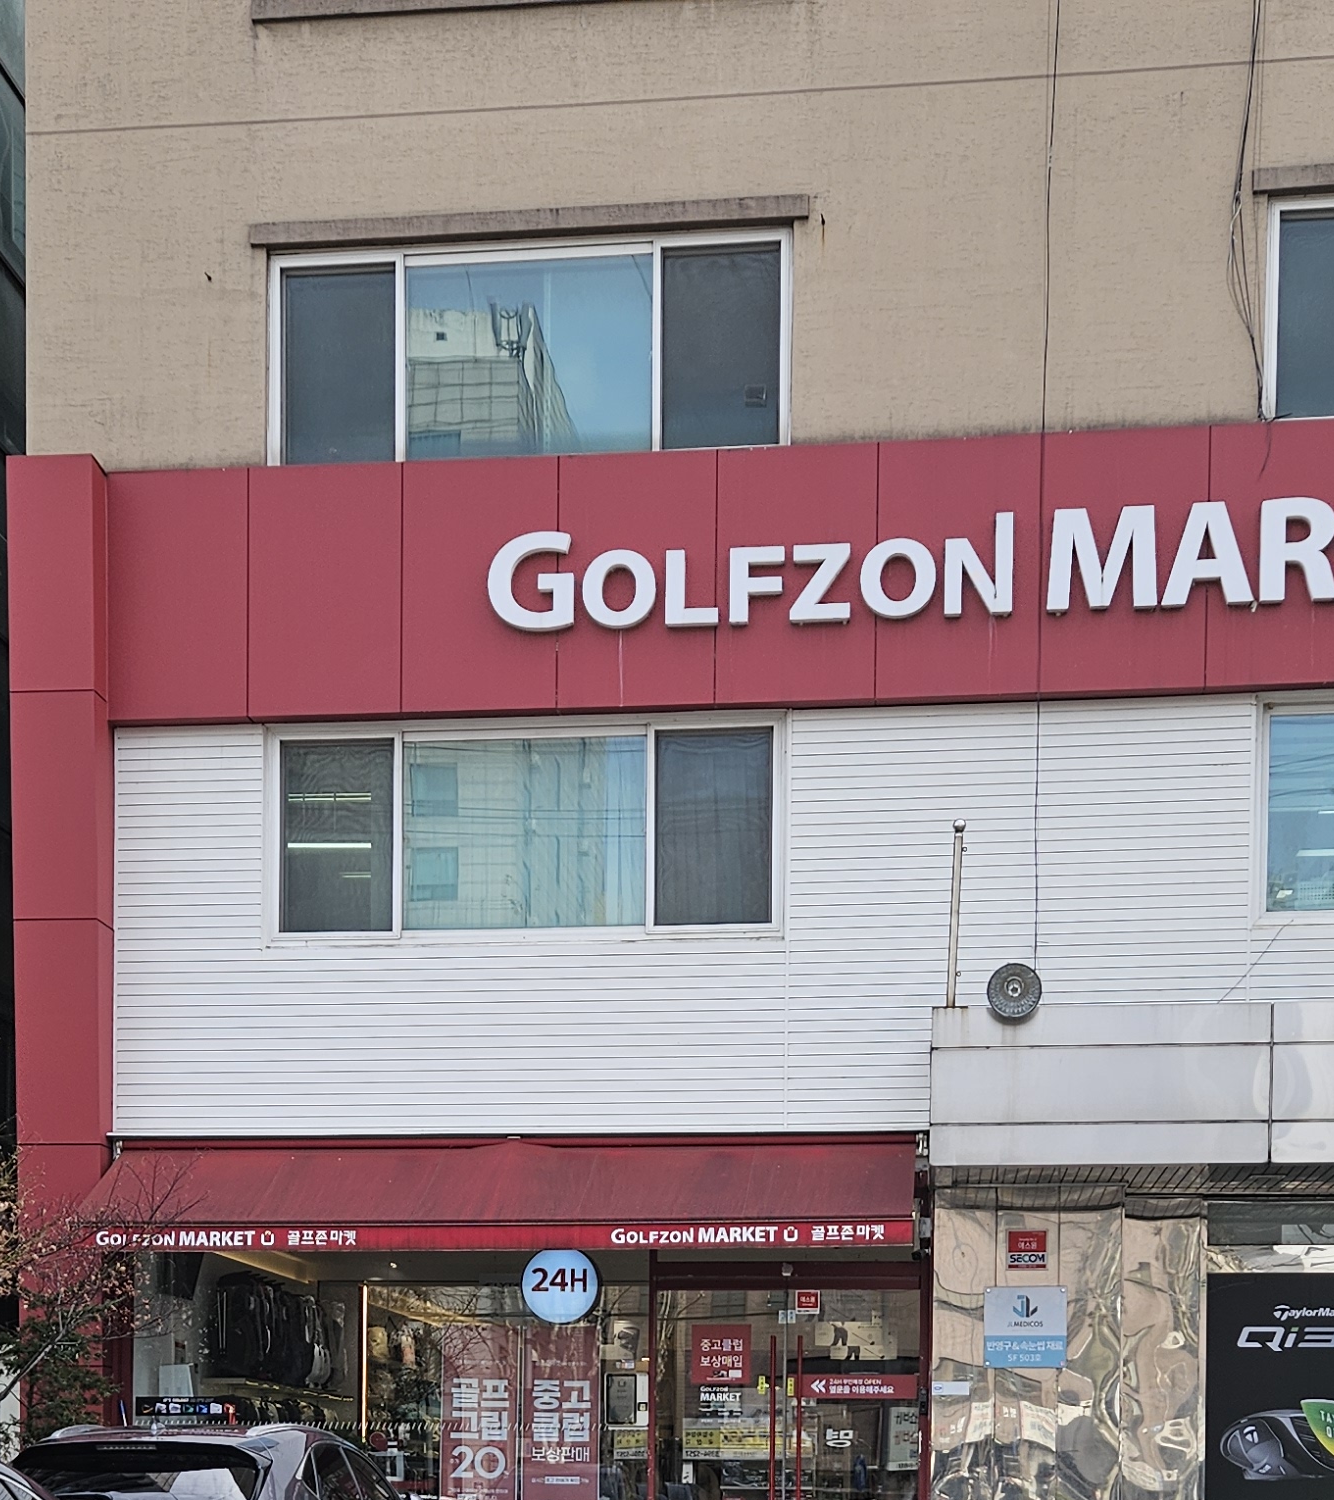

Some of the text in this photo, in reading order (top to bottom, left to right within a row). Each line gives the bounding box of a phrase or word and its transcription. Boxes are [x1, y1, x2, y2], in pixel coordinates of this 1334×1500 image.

[487, 511, 1013, 632] GOLFZON
[178, 1230, 255, 1247] MARKET
[287, 1229, 357, 1246] 골프존마켓
[611, 1226, 778, 1244] GOLFZON MARKET
[810, 1224, 885, 1241] 골프존마켓
[1009, 1253, 1045, 1263] SECOM
[531, 1267, 588, 1293] 24H
[700, 1339, 743, 1352] 중고클럽
[700, 1355, 743, 1368] 보상매입
[451, 1378, 510, 1408] 골프
[532, 1379, 592, 1410] 중고
[700, 1392, 742, 1402] MARKET
[450, 1411, 508, 1441] 그립
[533, 1411, 591, 1442] 클럽
[531, 1447, 590, 1463] 보상판매
